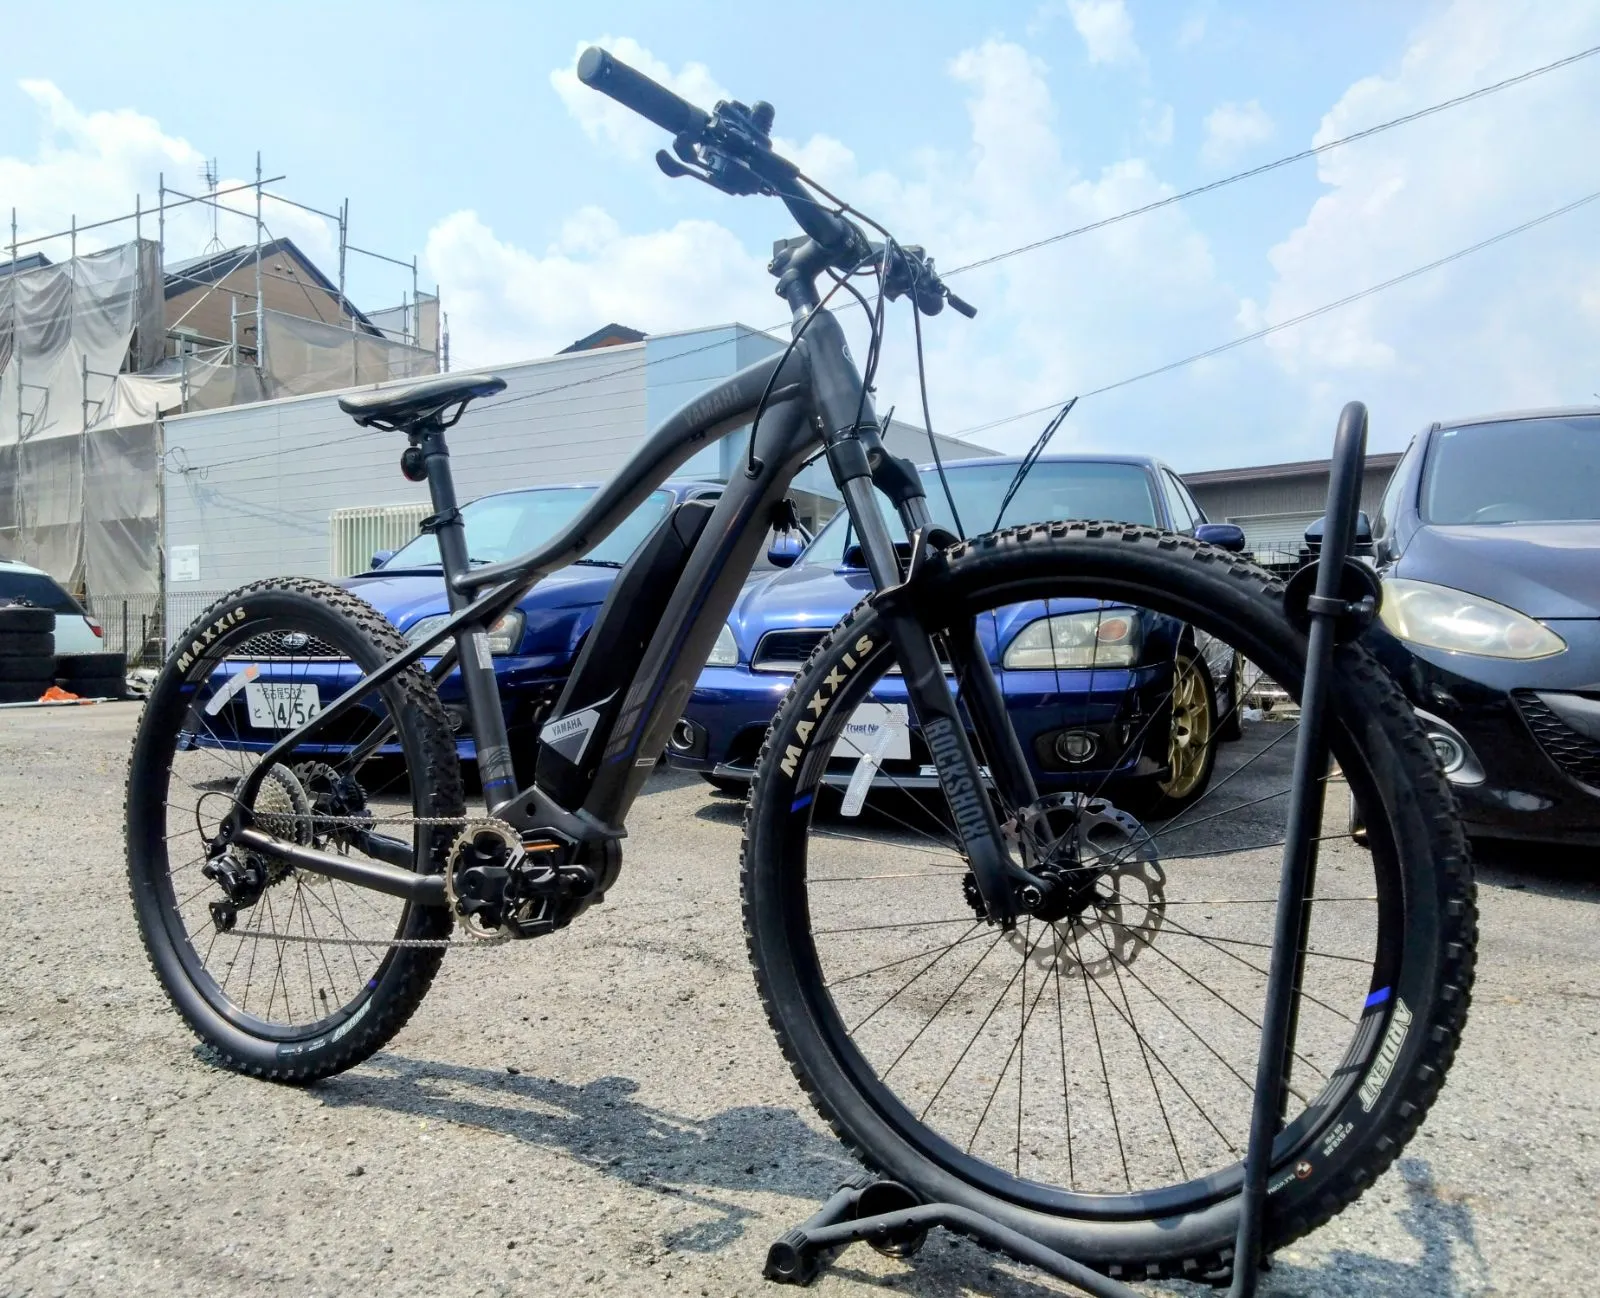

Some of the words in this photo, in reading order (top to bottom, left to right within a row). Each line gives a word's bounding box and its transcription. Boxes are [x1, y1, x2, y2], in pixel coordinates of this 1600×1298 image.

[681, 384, 743, 427] YAMAHA
[176, 606, 247, 674] MAXXIS
[551, 717, 583, 737] YAMAHA
[779, 633, 874, 779] MAXXIS
[846, 723, 866, 734] Trust
[924, 718, 990, 842] ROCKSHOX
[1358, 996, 1413, 1113] ARDENT
